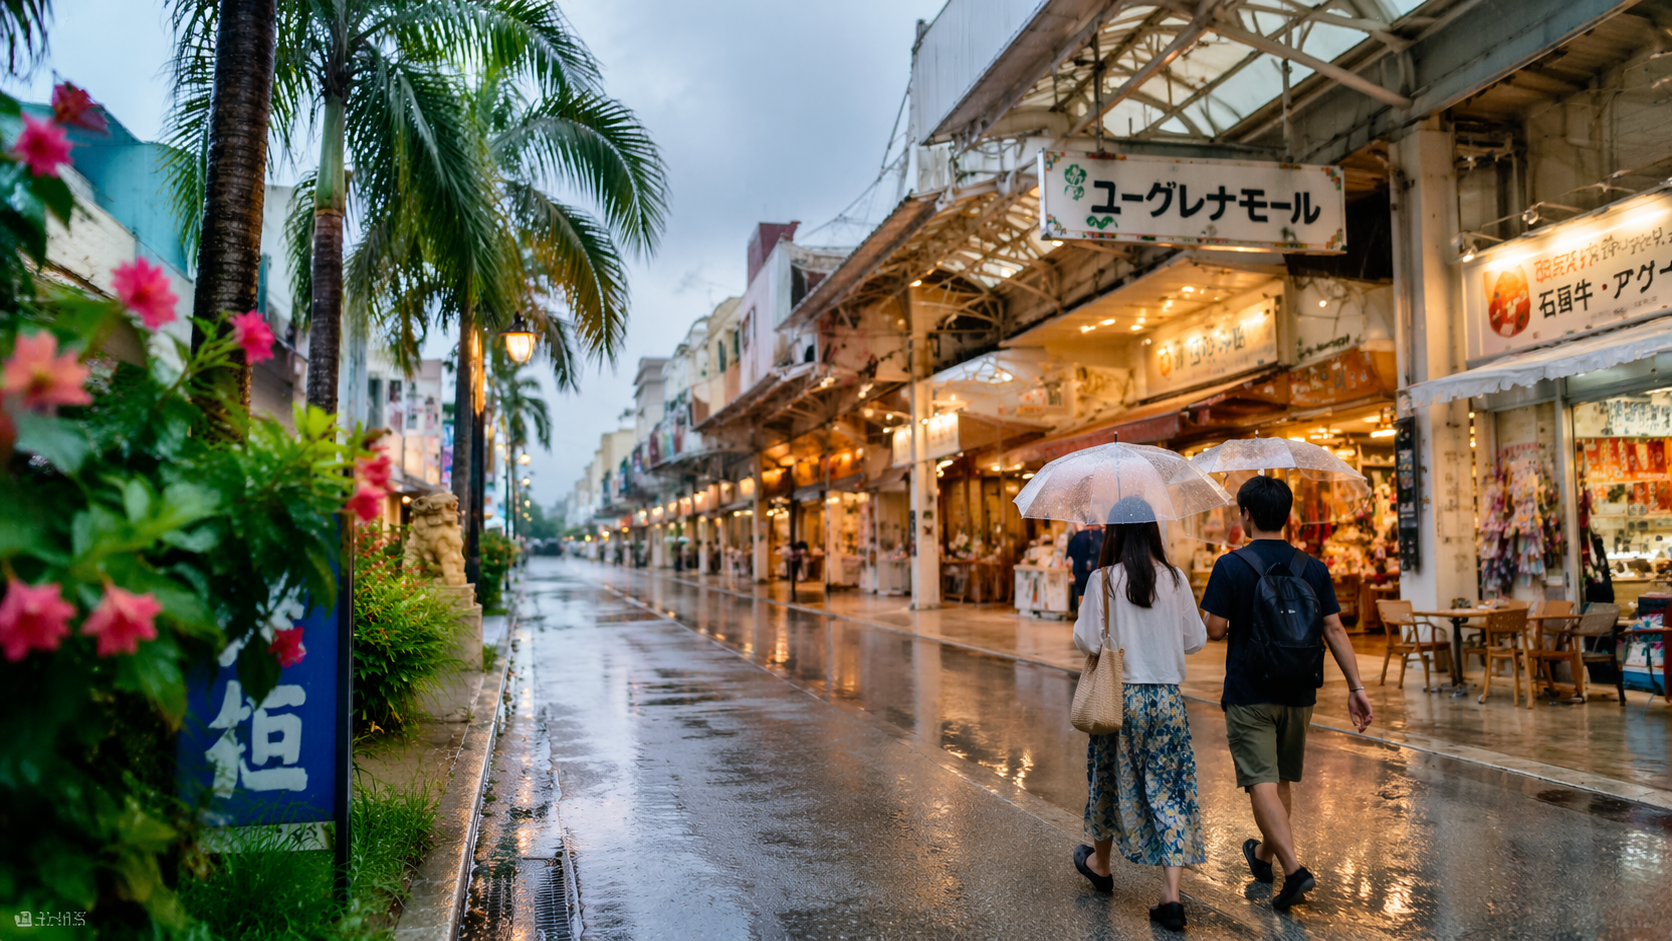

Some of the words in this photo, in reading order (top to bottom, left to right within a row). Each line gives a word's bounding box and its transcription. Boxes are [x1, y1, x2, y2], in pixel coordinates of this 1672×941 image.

[1091, 180, 1321, 225] ユーグレナモール
